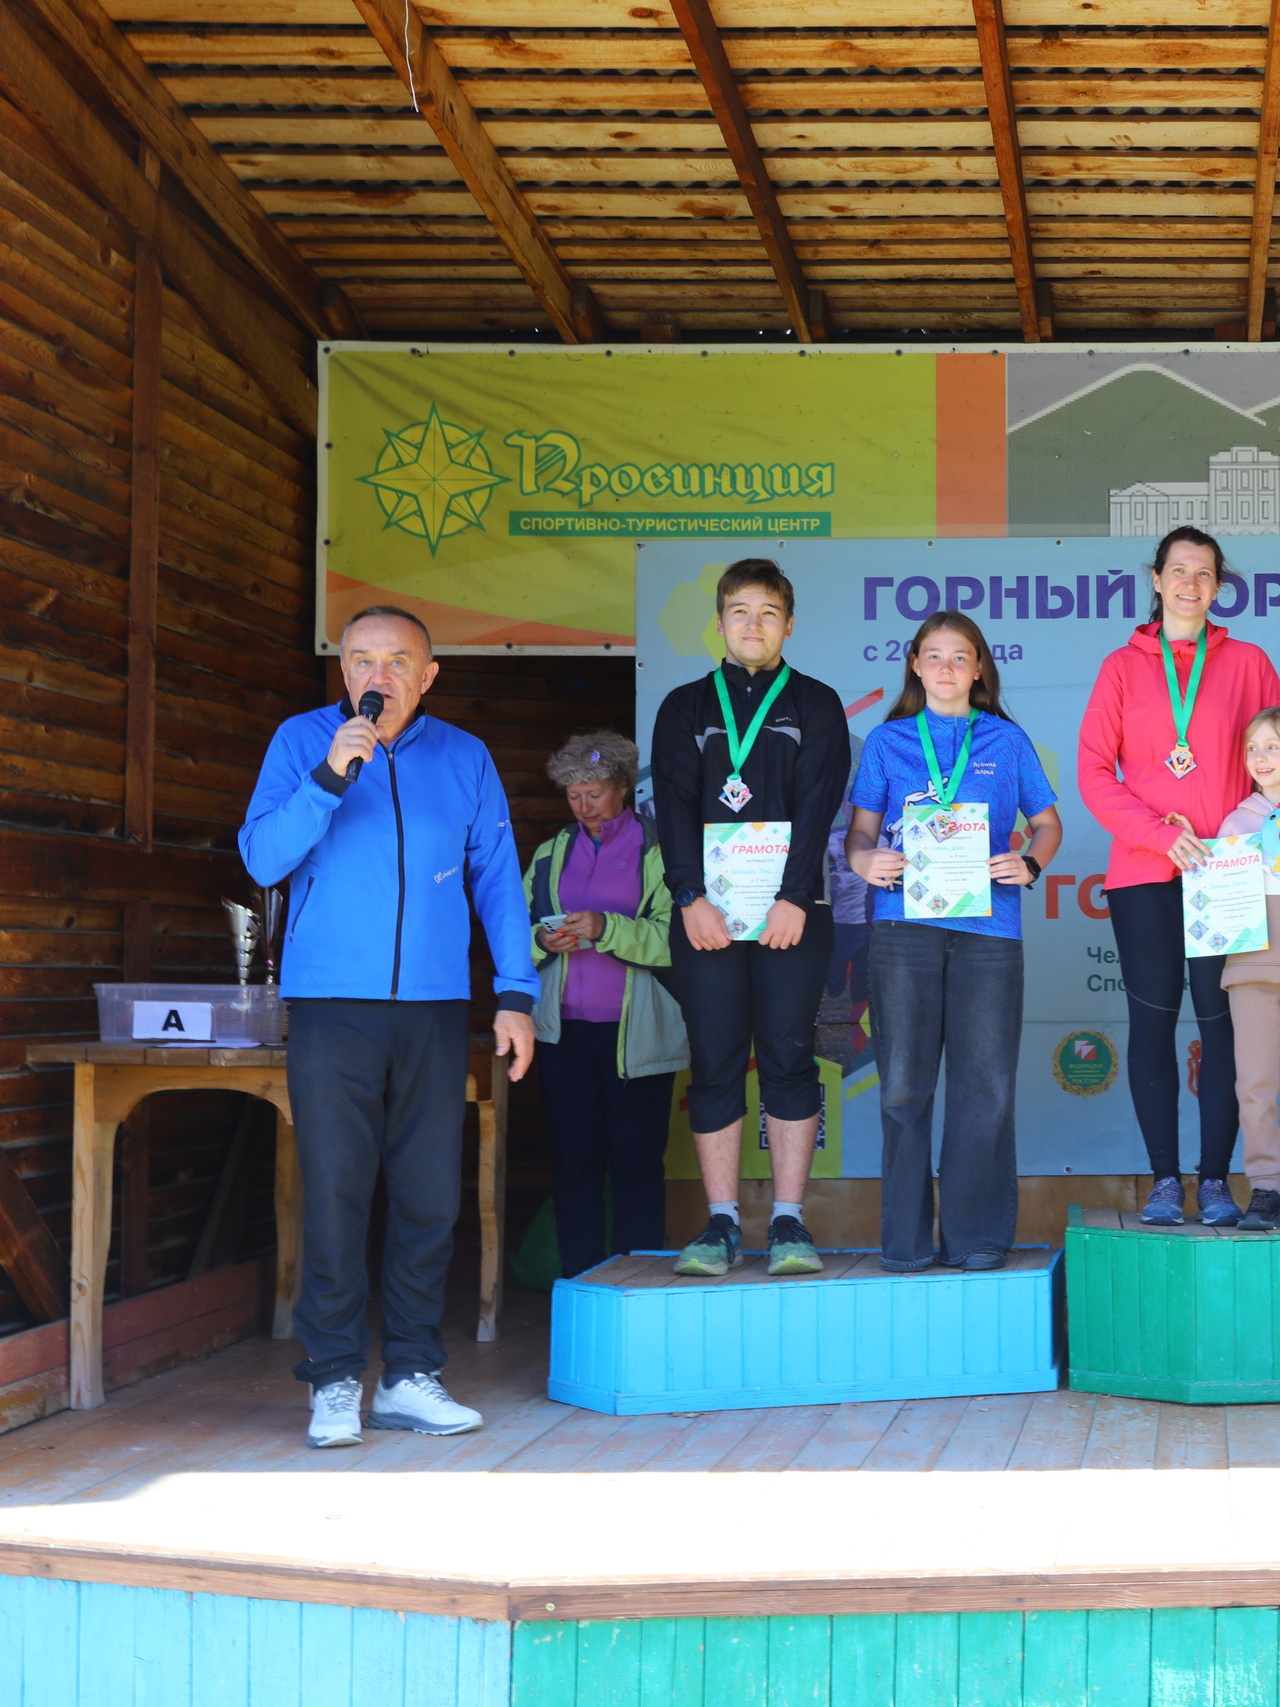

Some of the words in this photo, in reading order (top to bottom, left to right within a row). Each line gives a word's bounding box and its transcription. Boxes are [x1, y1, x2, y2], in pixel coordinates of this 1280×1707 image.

[503, 430, 835, 509] Провинция
[519, 516, 762, 533] СПОРТИВНО-ТУРИСТИЧЕСКИЙ
[767, 518, 821, 534] ЦЕНТР
[863, 569, 1136, 621] ГОРНЫЙ
[741, 787, 750, 798] 2
[948, 821, 957, 831] 2
[731, 844, 789, 855] ГРАМОТА
[1208, 854, 1260, 870] ГРАМОТА
